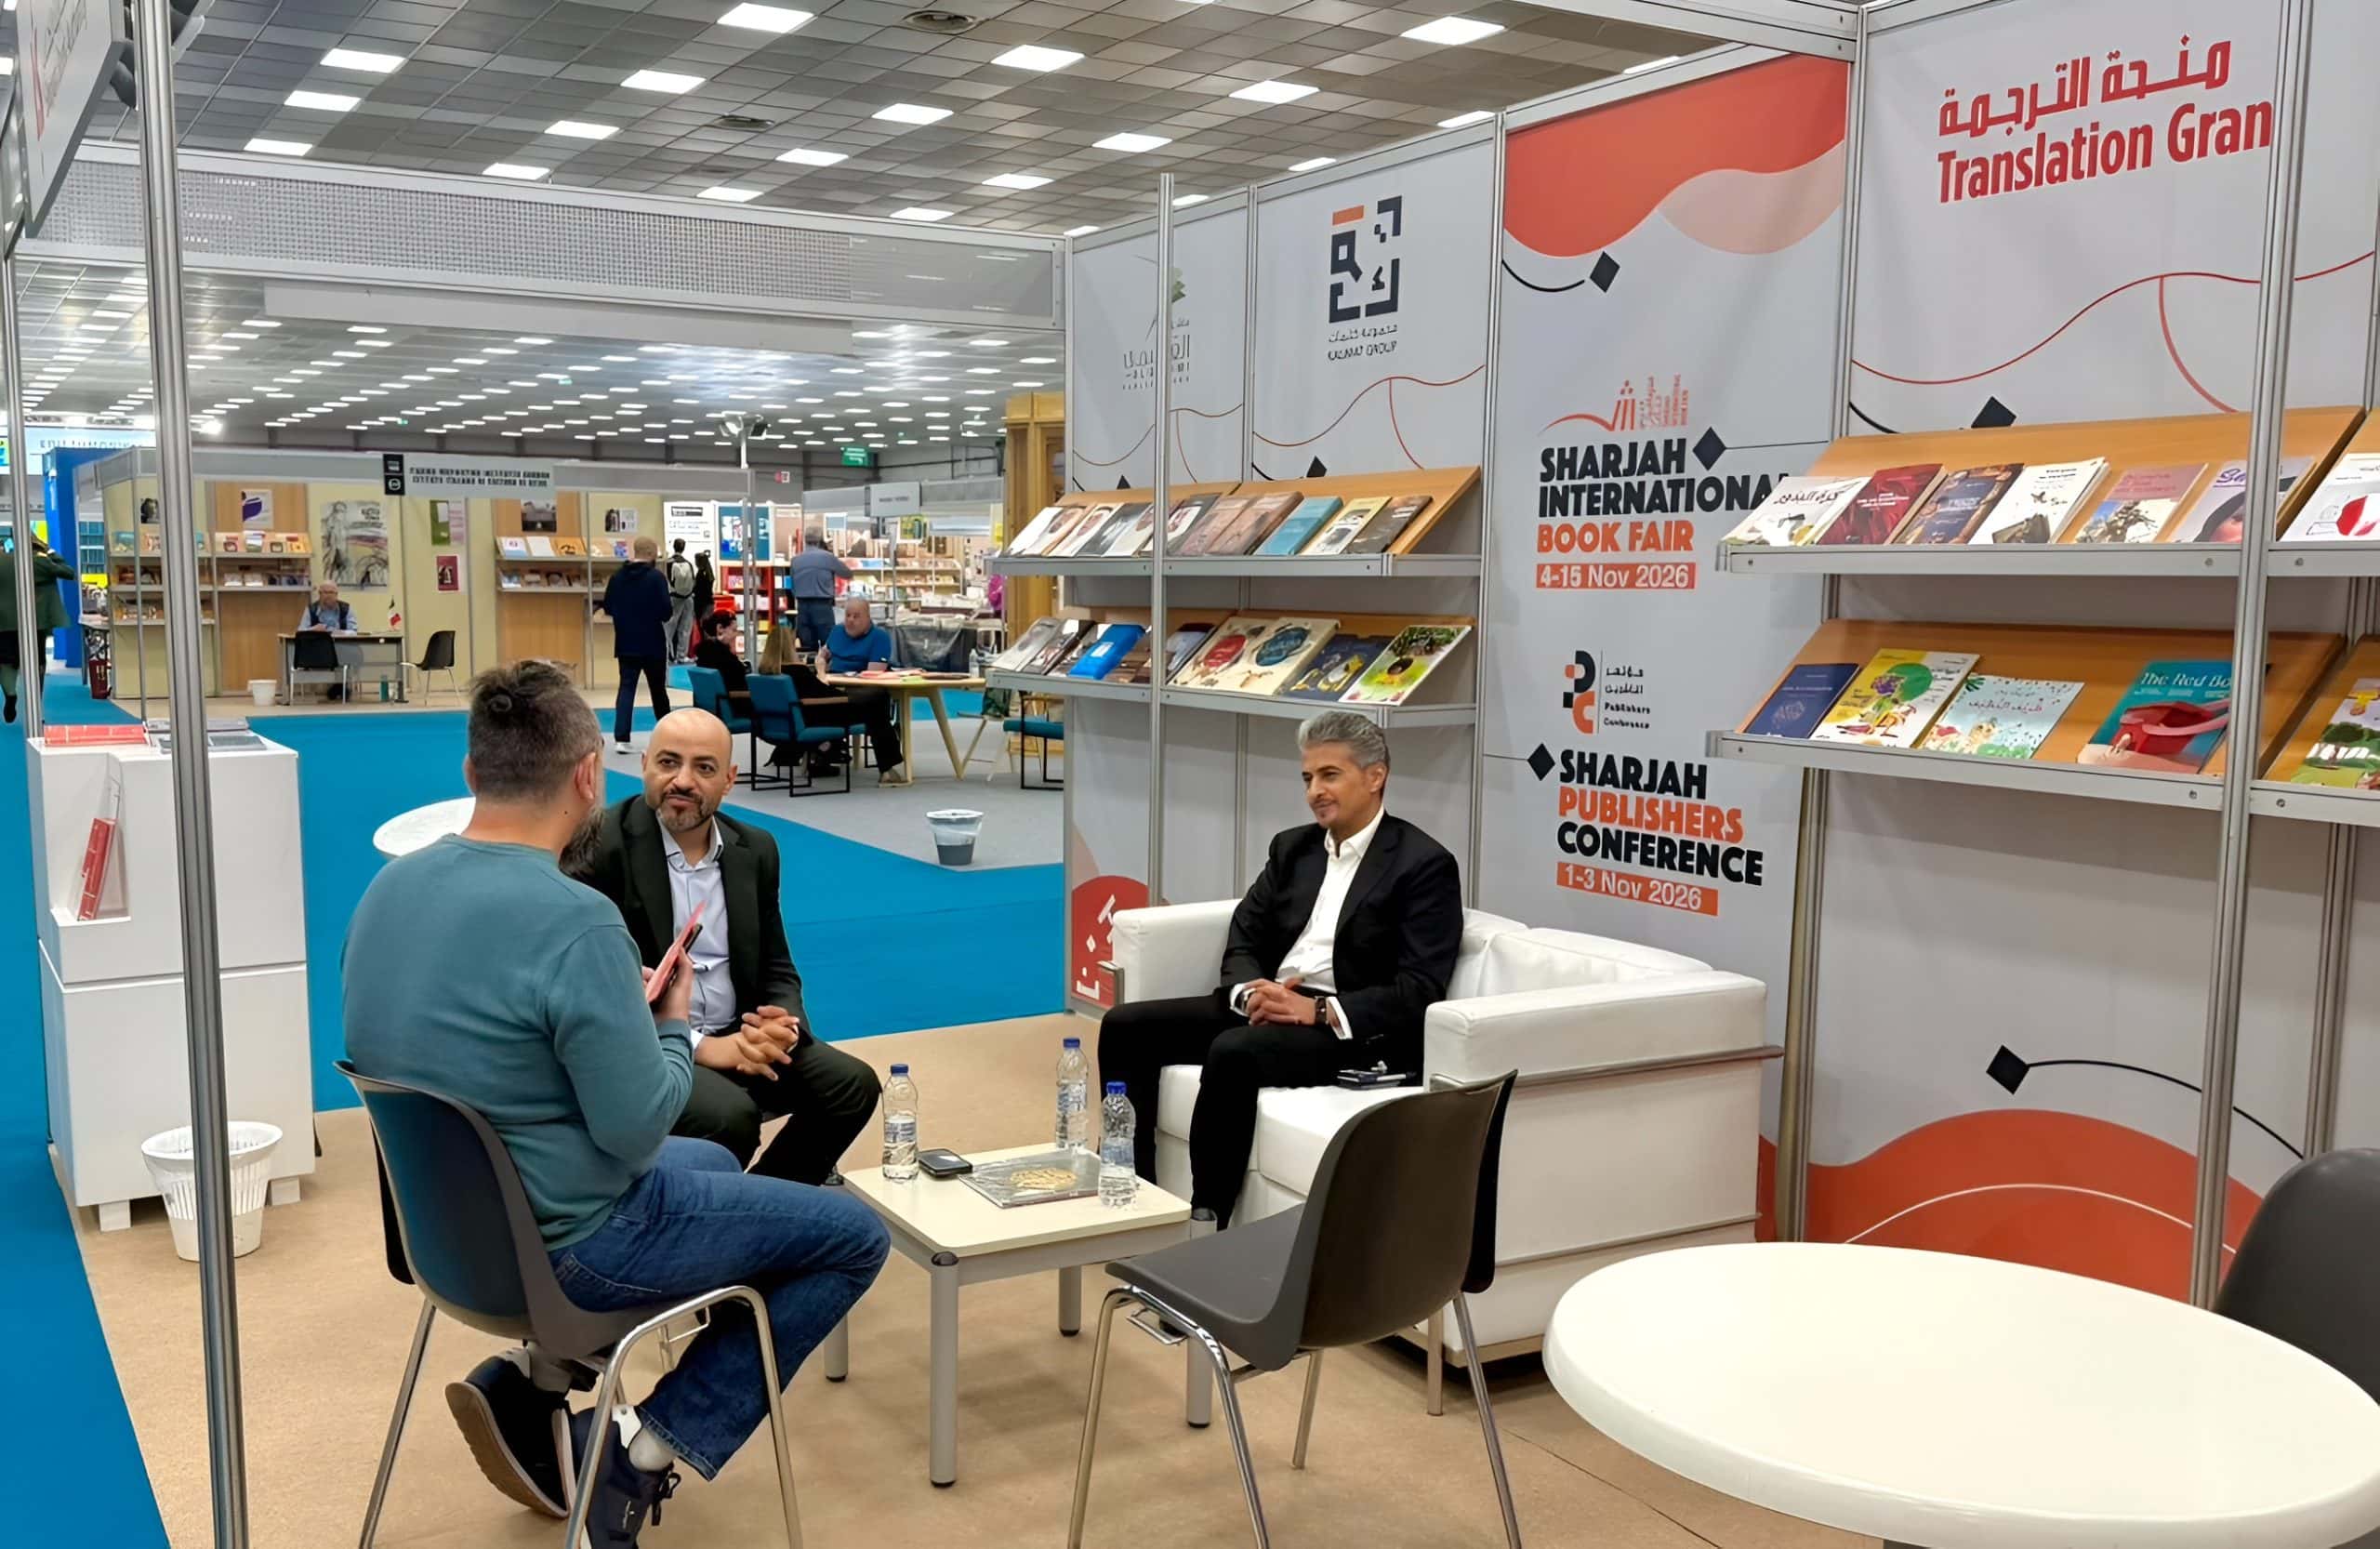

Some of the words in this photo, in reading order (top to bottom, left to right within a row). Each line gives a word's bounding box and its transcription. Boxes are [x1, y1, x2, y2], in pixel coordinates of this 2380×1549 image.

[2100, 33, 2232, 103] منحة
[1938, 56, 2091, 138] الترجمة
[1937, 121, 2153, 204] Translation
[2167, 100, 2273, 164] Gran
[1540, 438, 1687, 483] SHARJAH
[1539, 472, 1790, 518] INTERNATIONA
[1537, 522, 1622, 553] BOOK
[1628, 520, 1695, 551] FAIR
[1540, 565, 1581, 588] 4-15
[1588, 565, 1629, 587] Nov
[1634, 564, 1689, 587] 2026
[1559, 748, 1708, 800] SHARJAH
[1558, 786, 1744, 843] PUBLISHERS
[1557, 821, 1763, 886] CONFERENCE
[1566, 865, 1595, 888] 1-3
[1601, 871, 1642, 900] Nov
[1647, 880, 1702, 910] 2026
